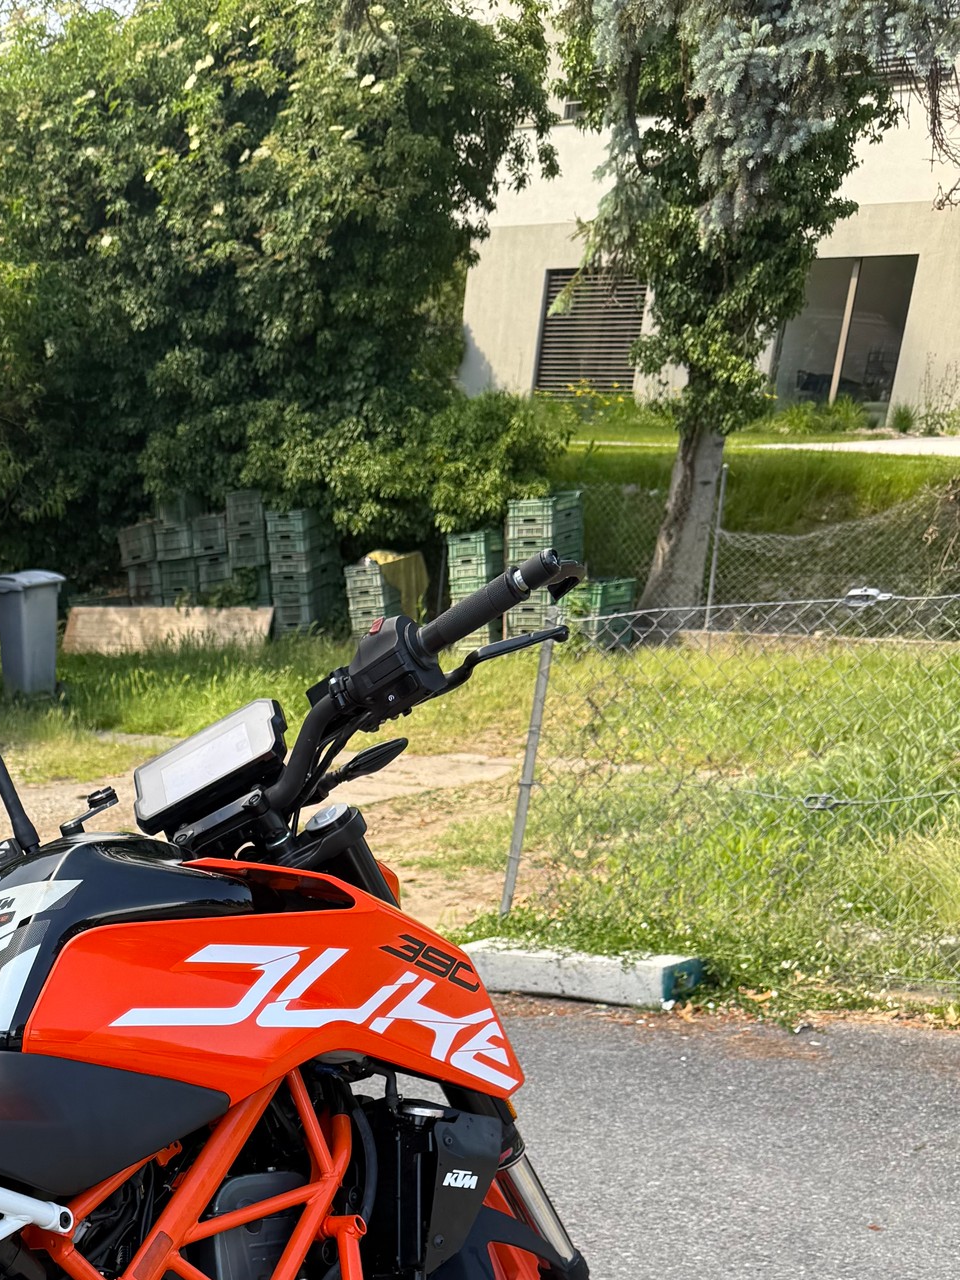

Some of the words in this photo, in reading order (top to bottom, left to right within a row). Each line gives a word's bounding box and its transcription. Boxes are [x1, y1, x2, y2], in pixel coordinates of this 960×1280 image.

[378, 934, 481, 993] 390
[107, 943, 520, 1091] DUKE
[442, 1169, 479, 1190] KTM
